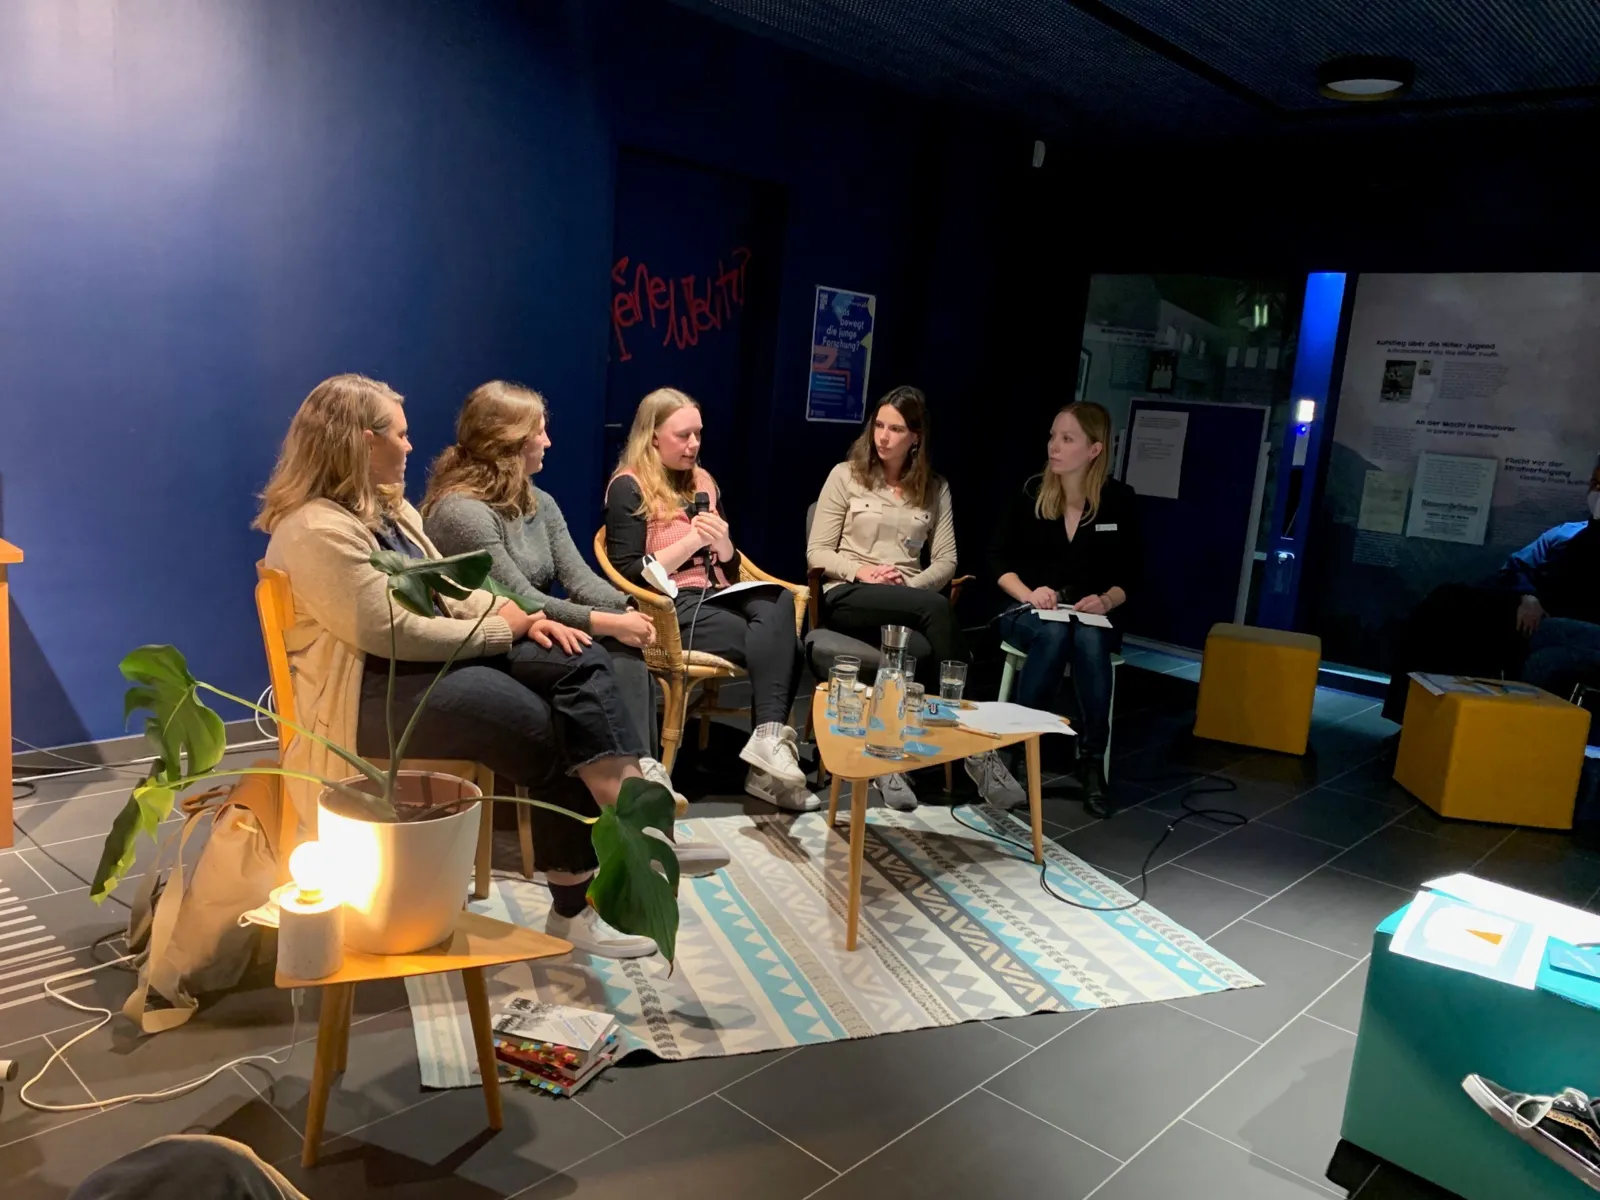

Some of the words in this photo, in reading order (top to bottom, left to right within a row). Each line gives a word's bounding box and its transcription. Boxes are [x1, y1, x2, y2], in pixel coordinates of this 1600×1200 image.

[840, 318, 865, 331] bewegt
[826, 325, 838, 336] die
[838, 327, 858, 341] junge
